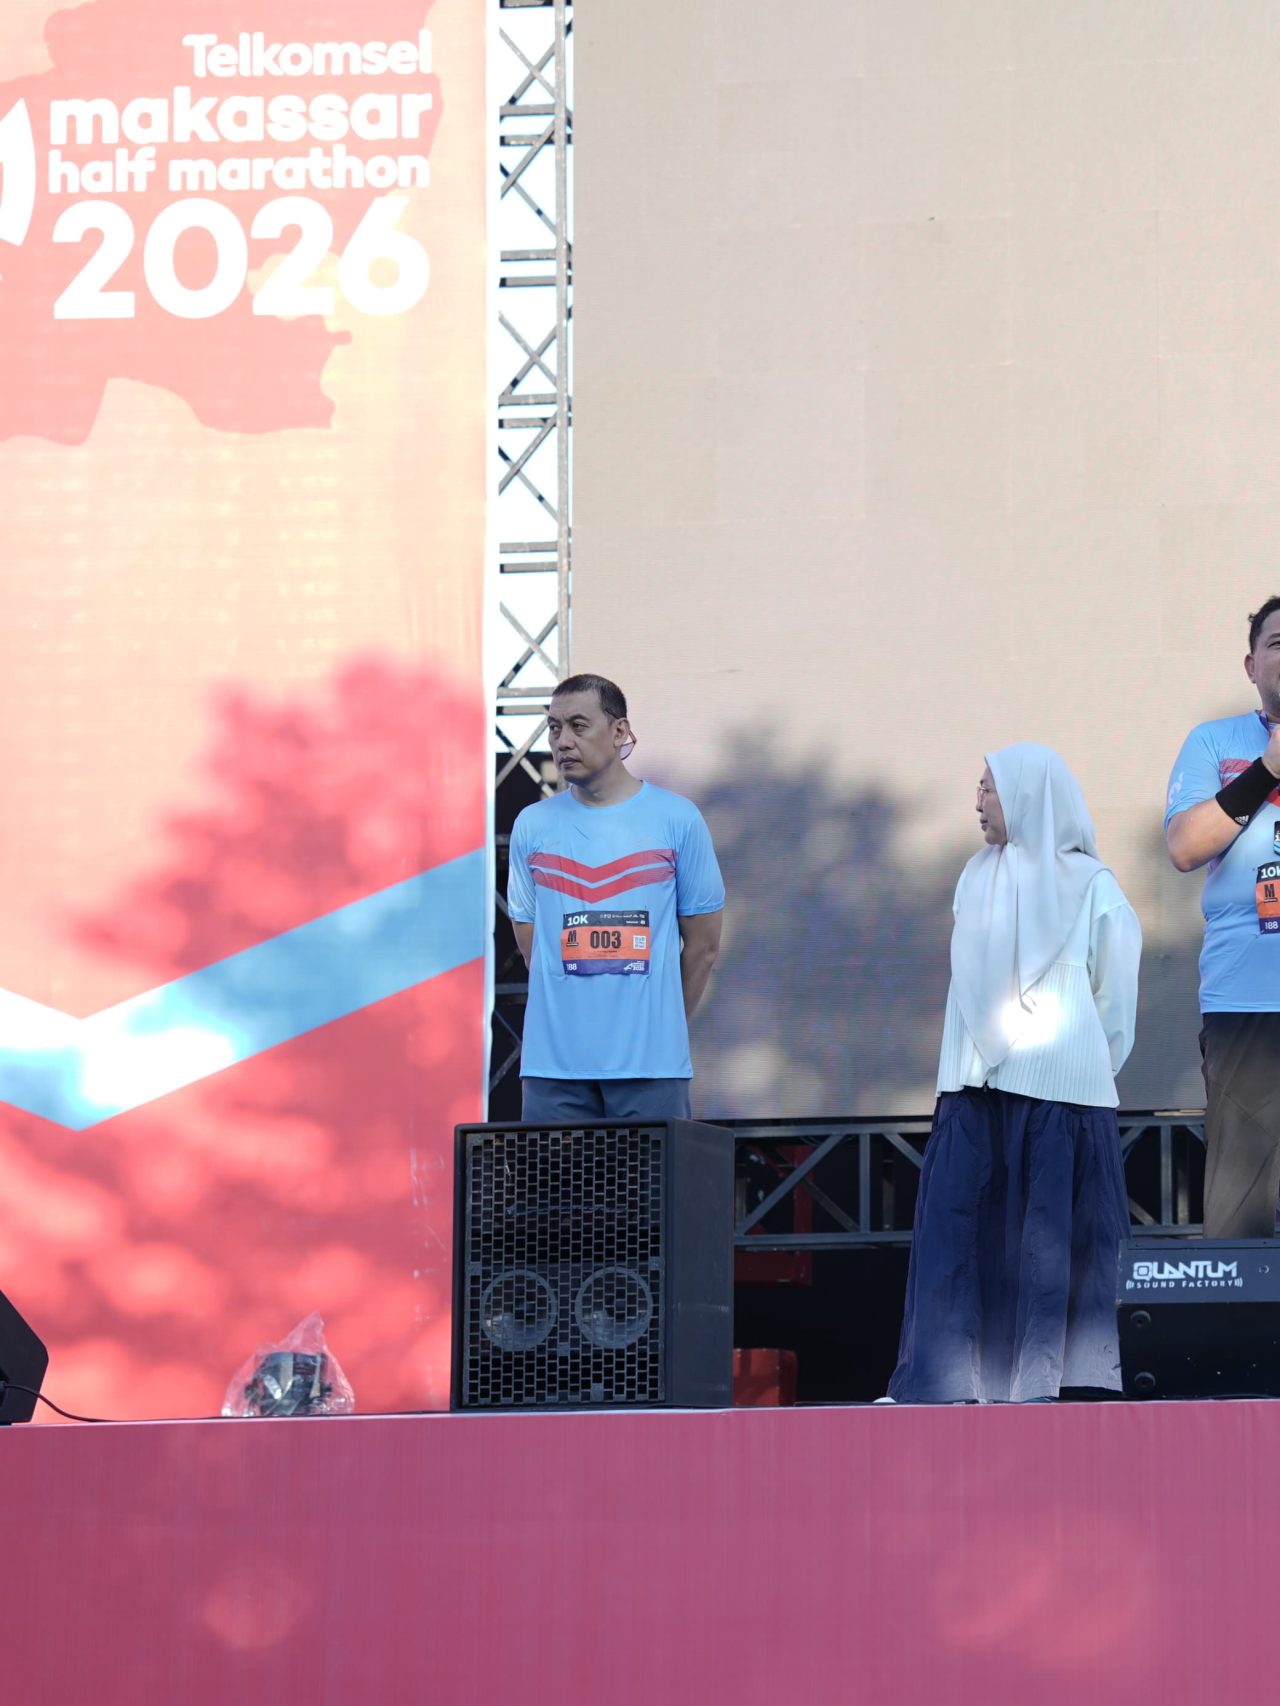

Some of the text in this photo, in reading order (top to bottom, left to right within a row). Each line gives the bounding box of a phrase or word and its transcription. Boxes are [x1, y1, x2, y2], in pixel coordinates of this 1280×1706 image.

[182, 28, 433, 77] Telkomsel
[49, 86, 434, 145] makassar
[48, 144, 431, 194] half marathon
[52, 195, 431, 320] 2026
[1264, 883, 1276, 898] M
[567, 914, 589, 926] 10K
[590, 930, 622, 949] 003
[1133, 1261, 1238, 1281] QUANTUM
[1136, 1280, 1233, 1289] SOUND FACTORY
